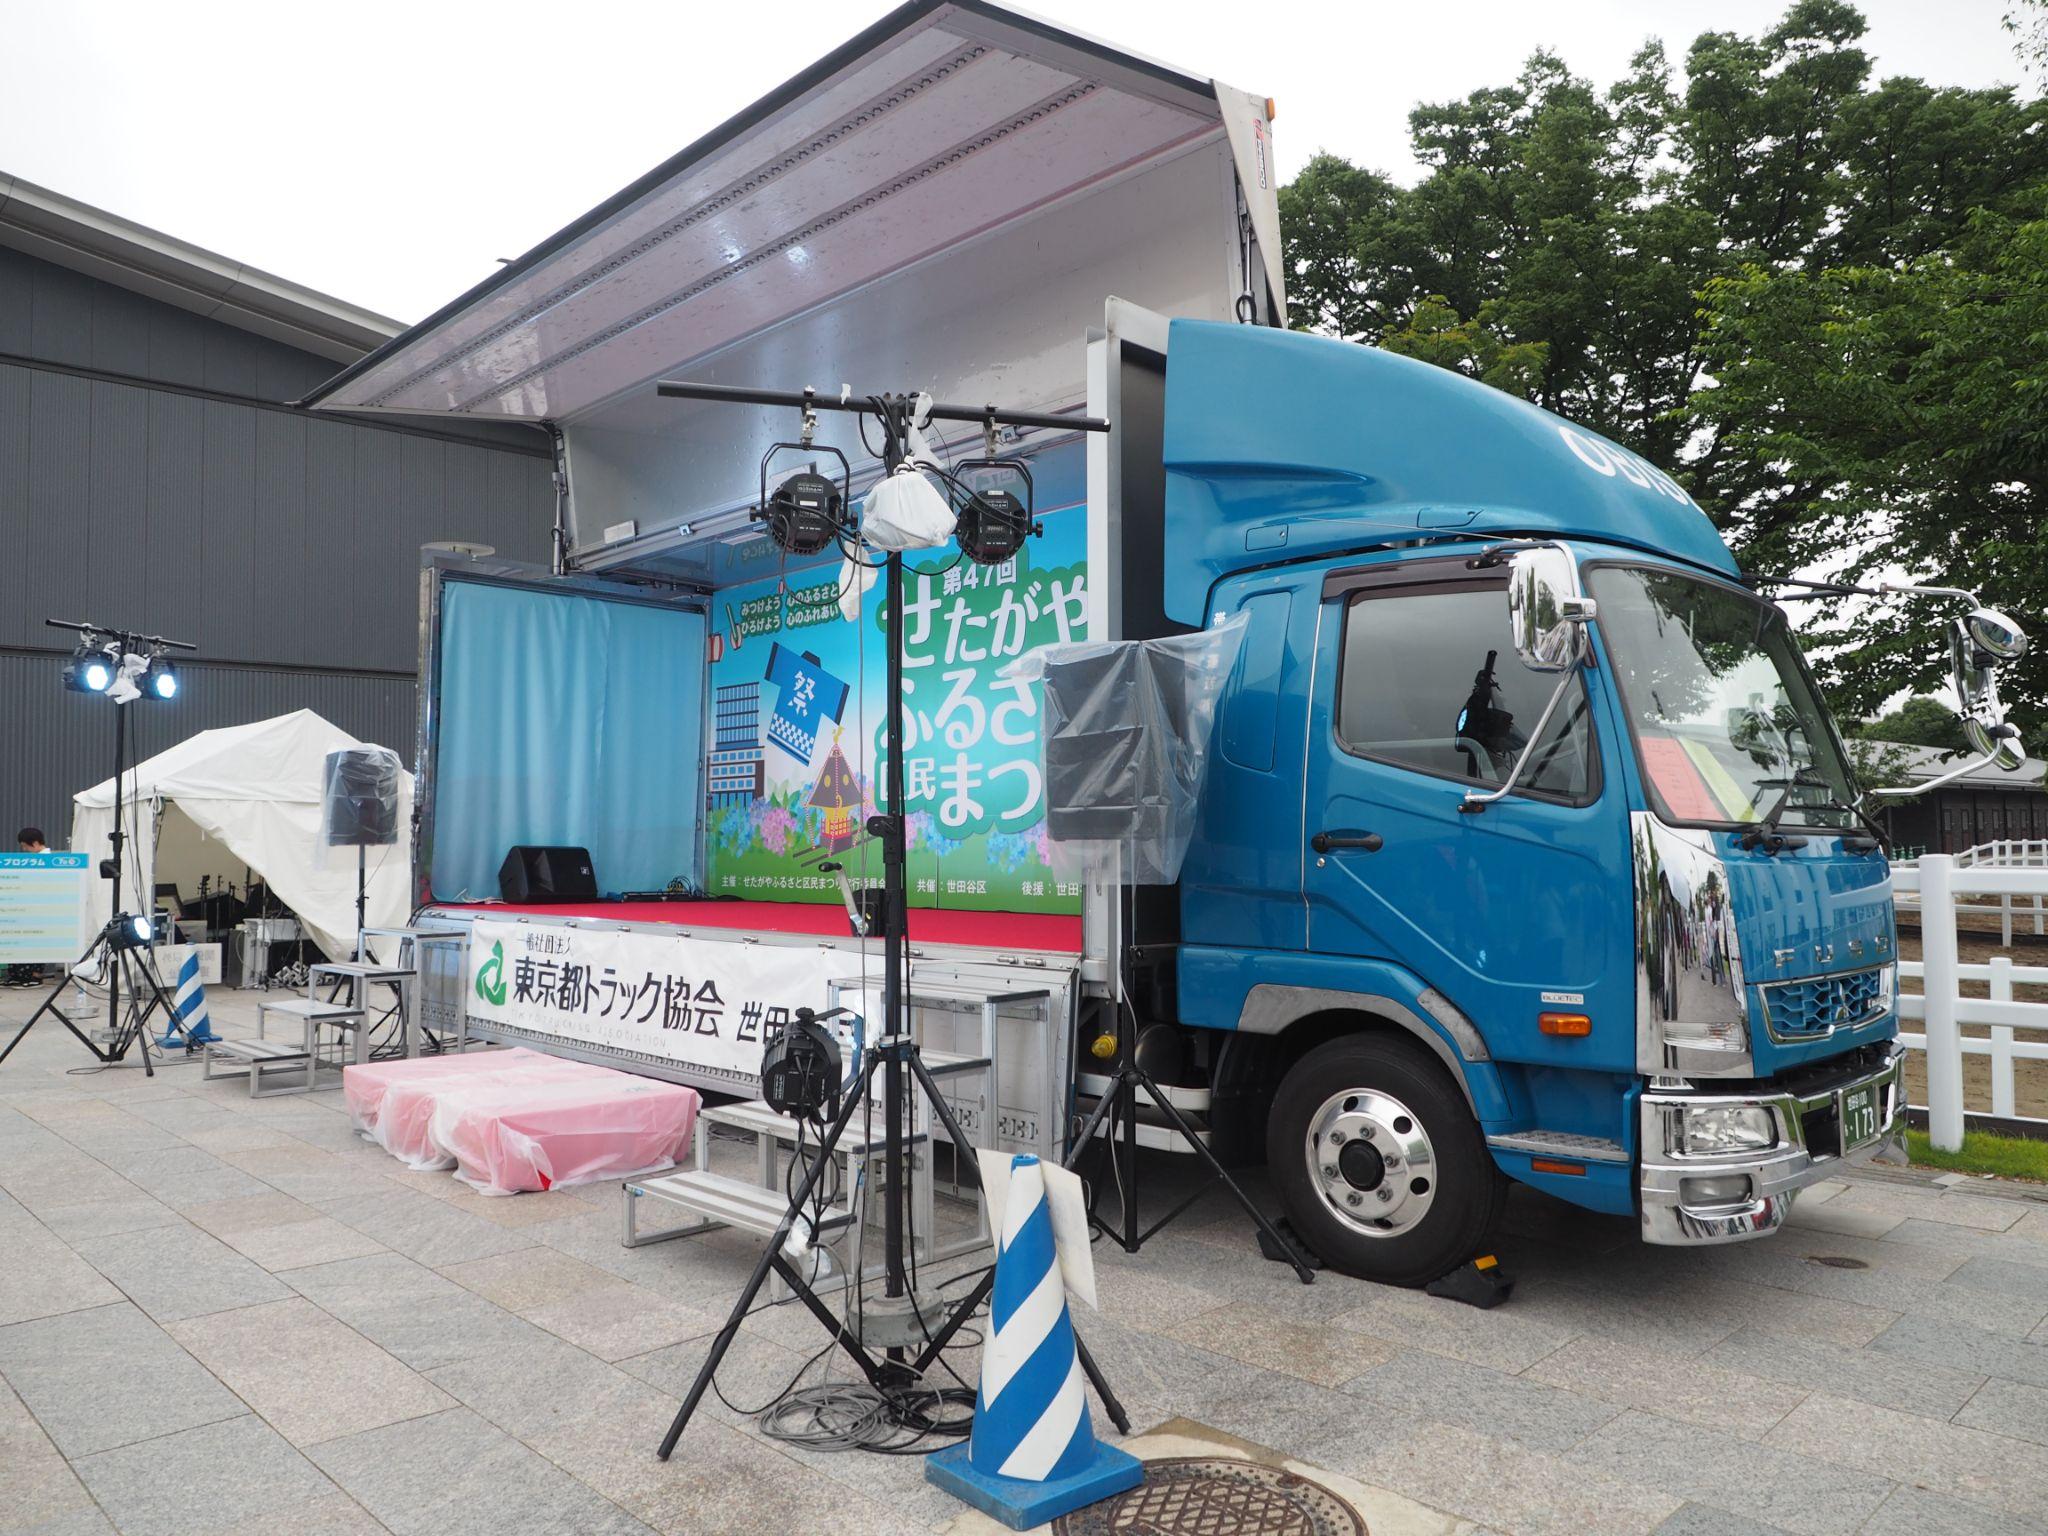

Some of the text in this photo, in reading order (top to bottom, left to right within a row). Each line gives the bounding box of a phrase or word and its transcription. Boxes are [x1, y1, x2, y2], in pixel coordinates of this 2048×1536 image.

[942, 555, 1017, 596] 第47回
[741, 583, 839, 616] みつけよう 心のふるさと
[786, 604, 840, 626] 心のふれあい
[882, 575, 1088, 668] せたがや
[787, 669, 816, 718] 祭
[0, 858, 46, 866] プログラム
[1021, 880, 1083, 897] 後援：世田
[1774, 935, 1889, 969] FUSO
[513, 955, 726, 1038] 東京都トラック協会
